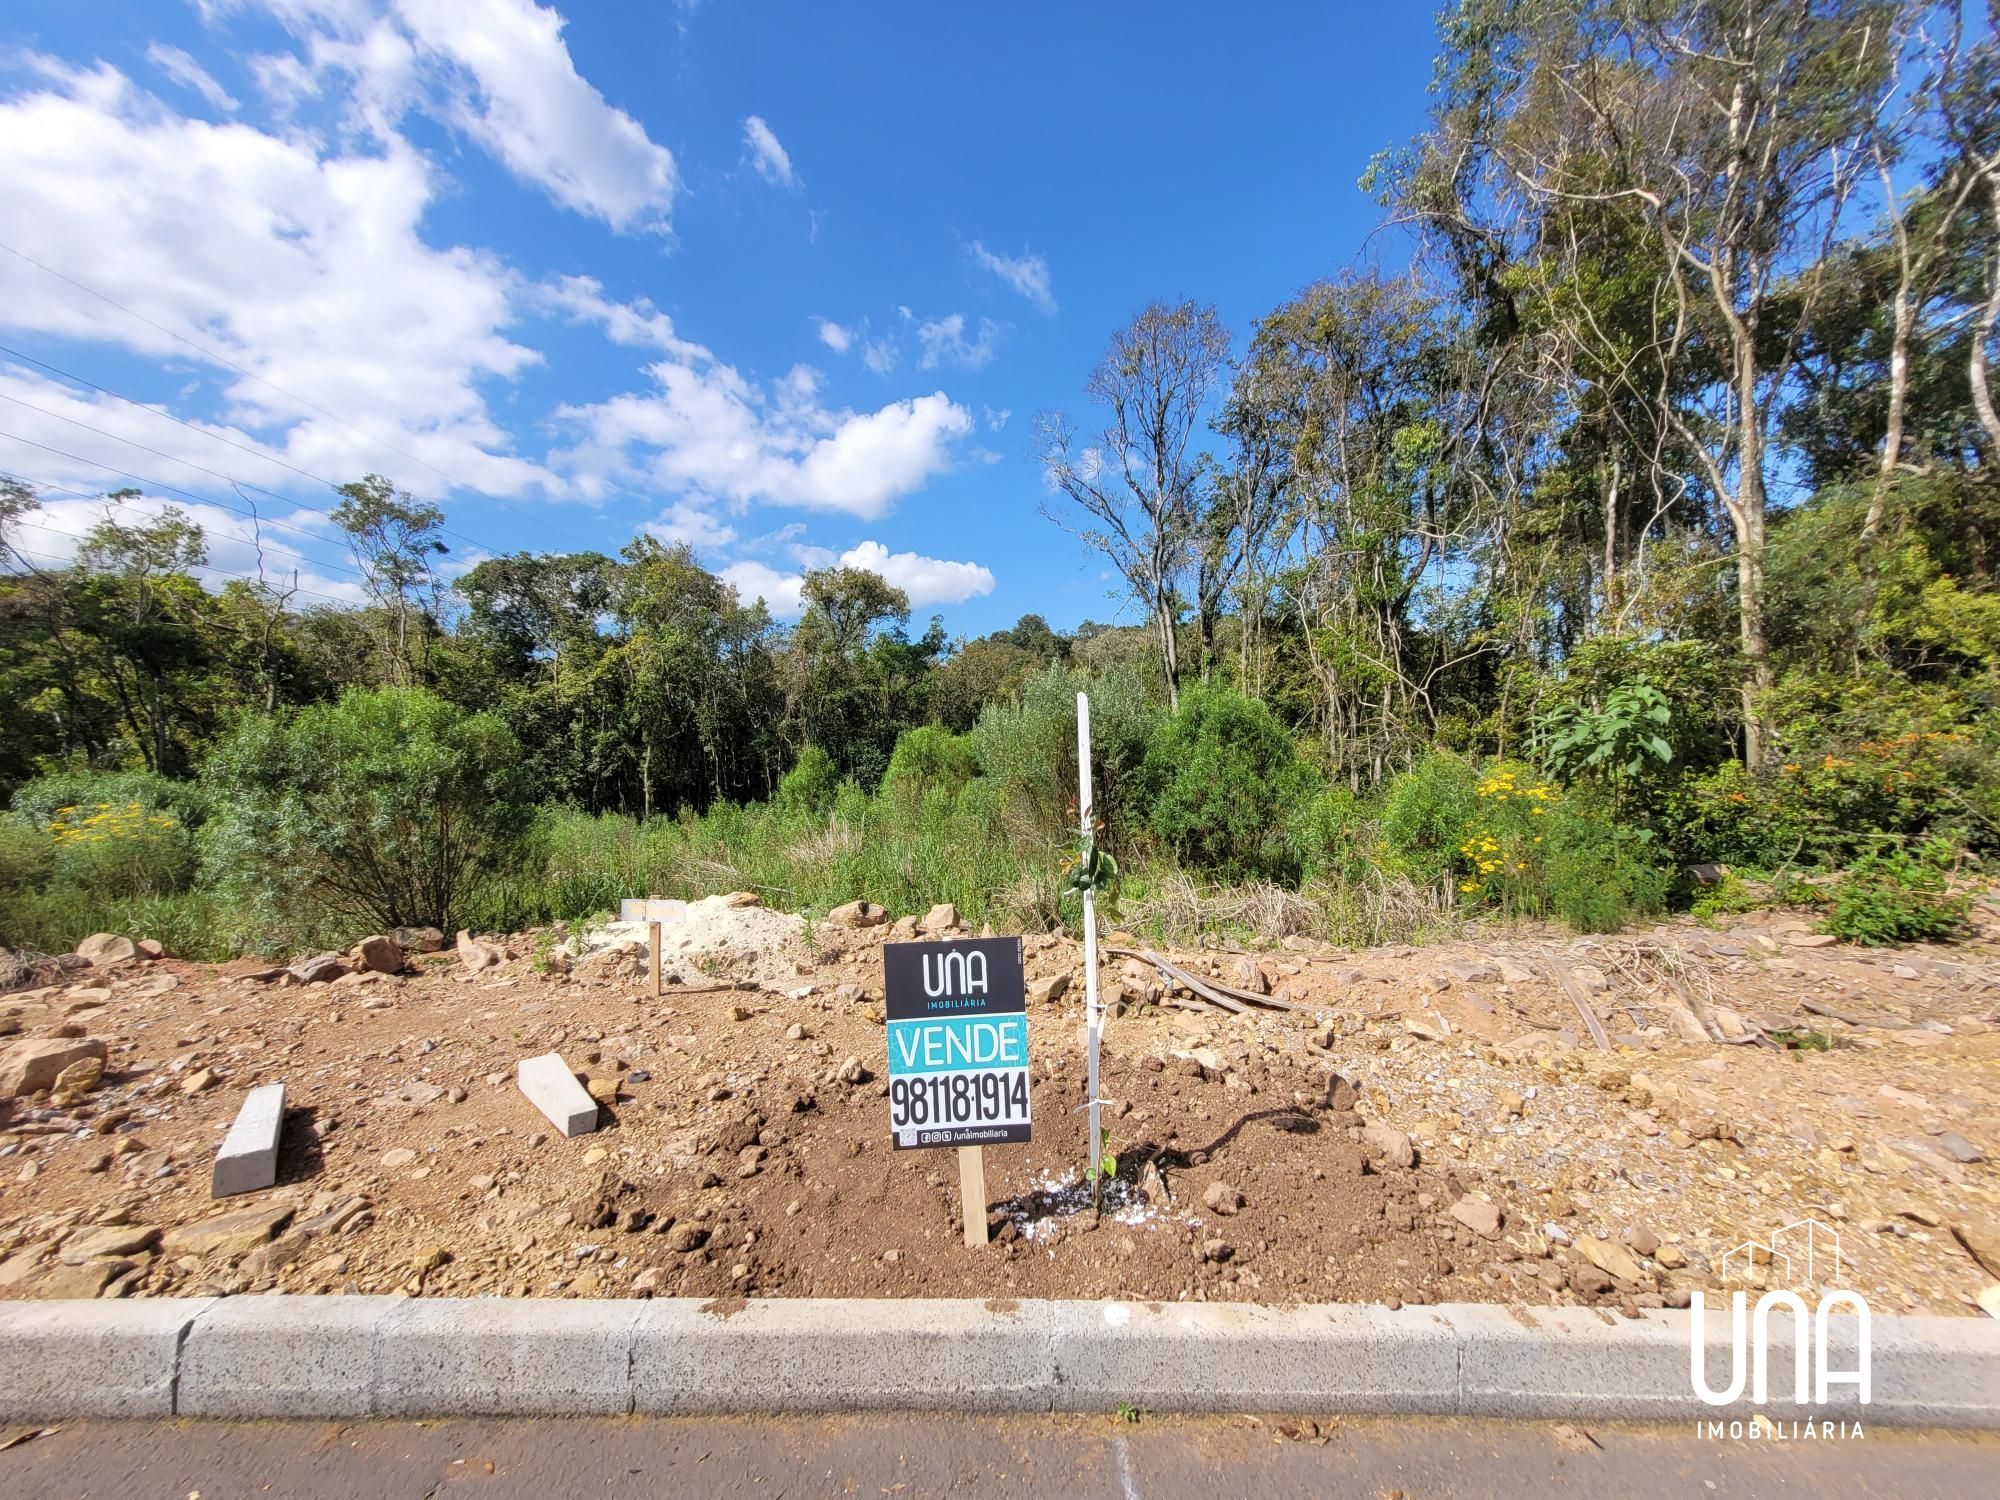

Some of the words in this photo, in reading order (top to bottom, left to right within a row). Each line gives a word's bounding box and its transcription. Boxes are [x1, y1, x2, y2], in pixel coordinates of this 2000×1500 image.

[922, 950, 988, 997] UNA
[927, 998, 986, 1010] IMOBILIÁRIA
[896, 1022, 1020, 1067] VENDE
